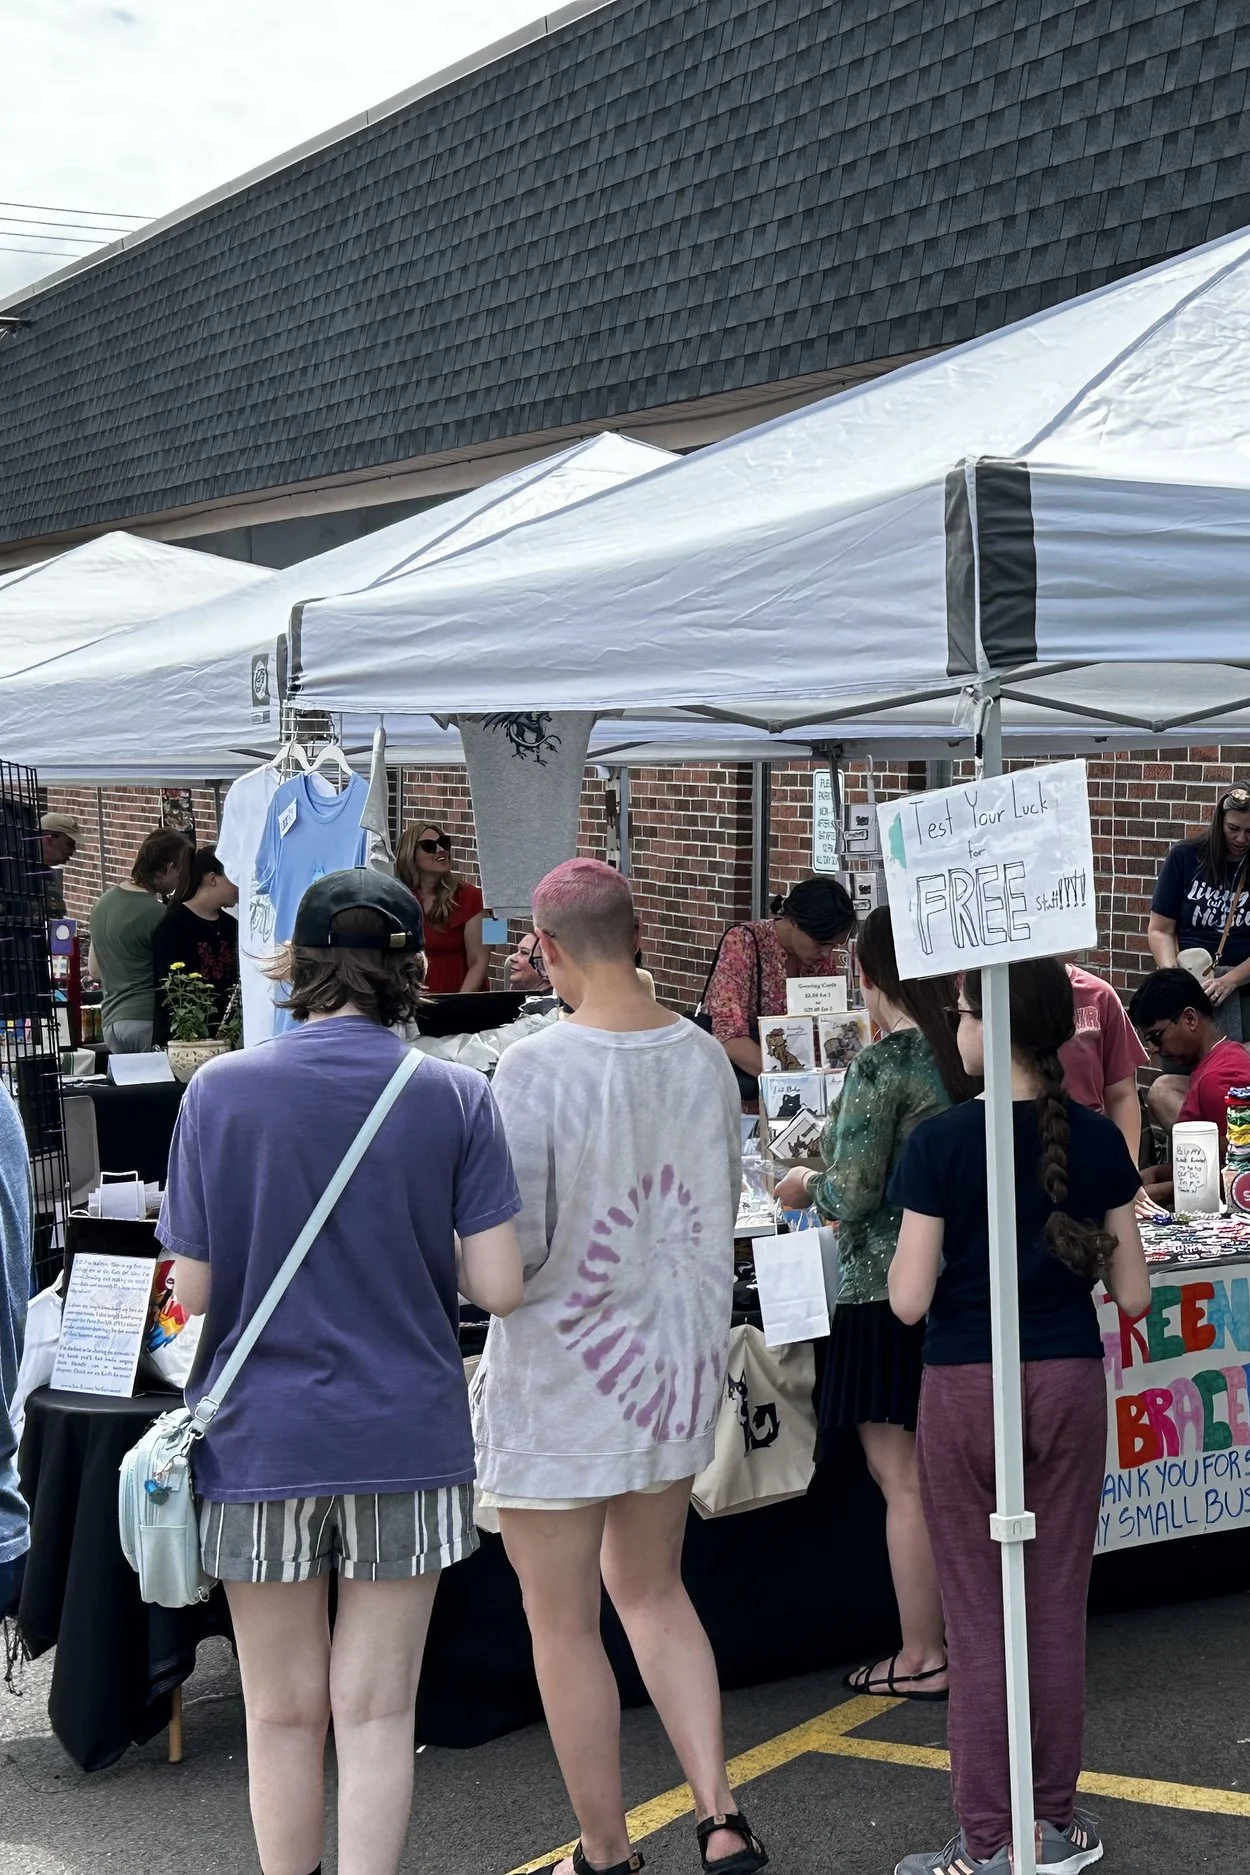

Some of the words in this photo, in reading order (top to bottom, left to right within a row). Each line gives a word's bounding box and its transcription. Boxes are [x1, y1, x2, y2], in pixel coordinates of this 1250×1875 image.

[909, 798, 953, 845] Test
[964, 790, 1005, 829] Your
[1011, 779, 1048, 819] Luck
[968, 840, 986, 859] for
[916, 861, 1031, 956] FREE
[1156, 1458, 1200, 1494] YOU
[1202, 1450, 1240, 1485] FOR
[1119, 1496, 1199, 1539] SMALL
